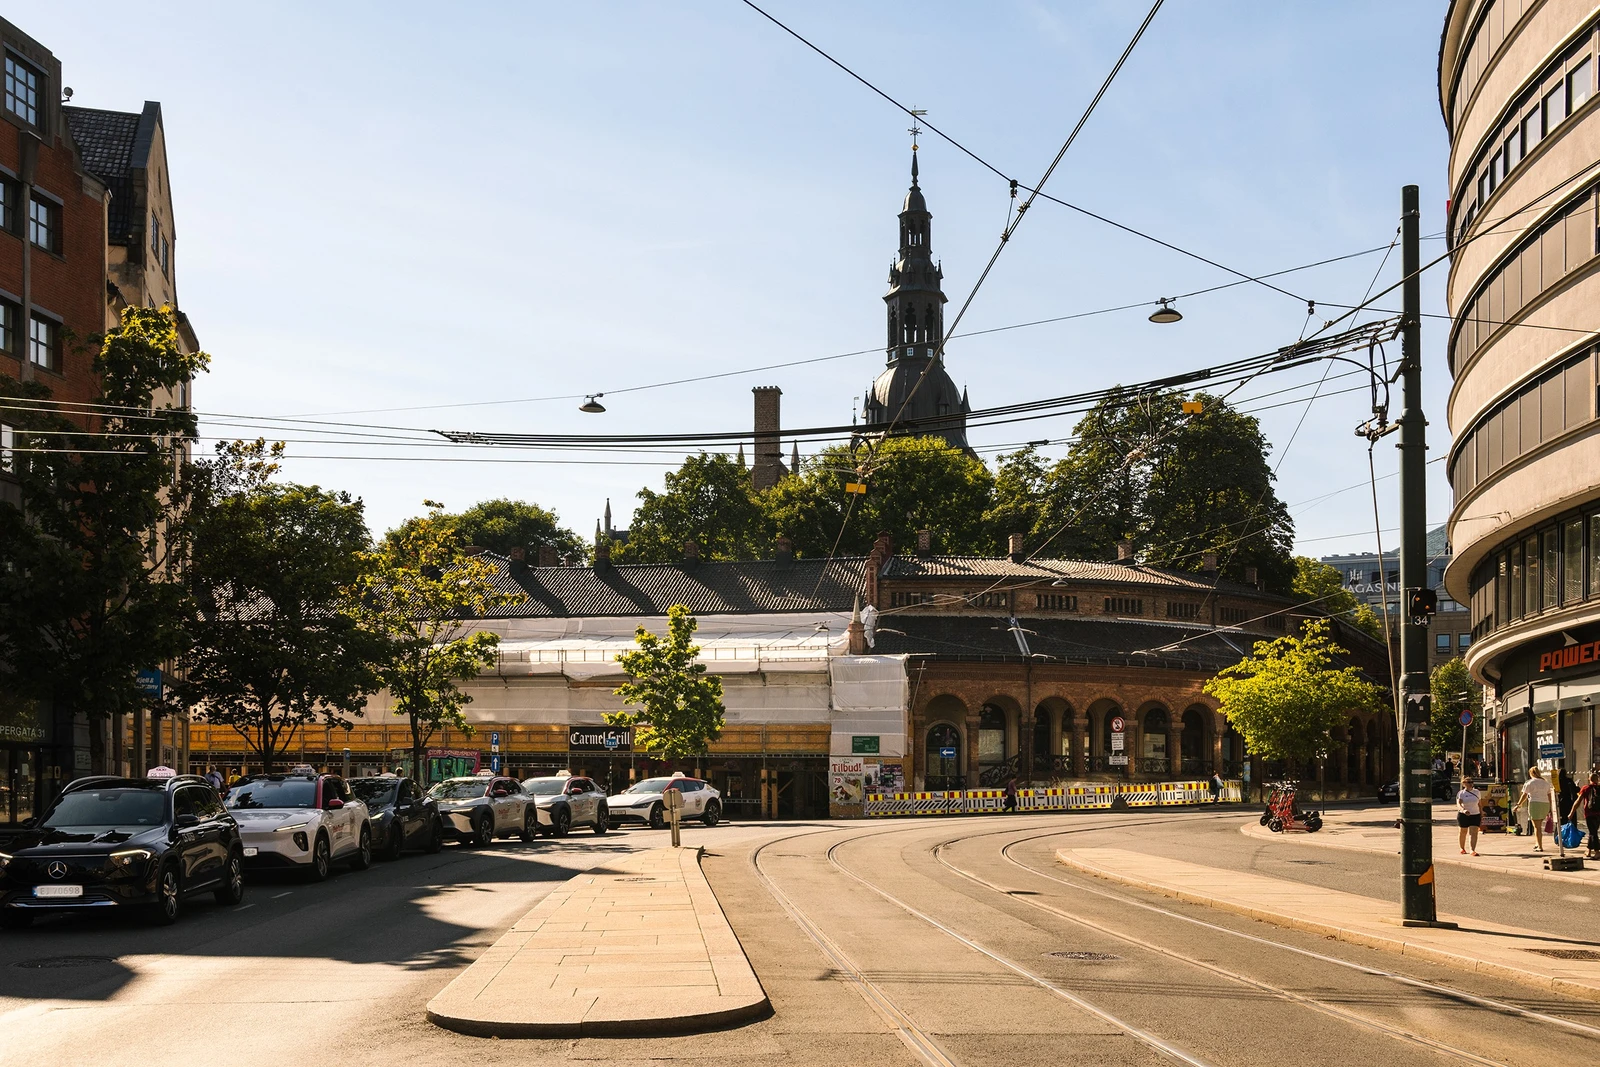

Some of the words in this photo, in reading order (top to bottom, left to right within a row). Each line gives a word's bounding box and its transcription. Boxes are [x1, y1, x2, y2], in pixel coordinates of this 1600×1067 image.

[1414, 615, 1428, 625] 34
[37, 728, 45, 738] 31
[570, 731, 605, 745] Carmel
[493, 733, 498, 744] P
[831, 763, 862, 772] Tilbud!
